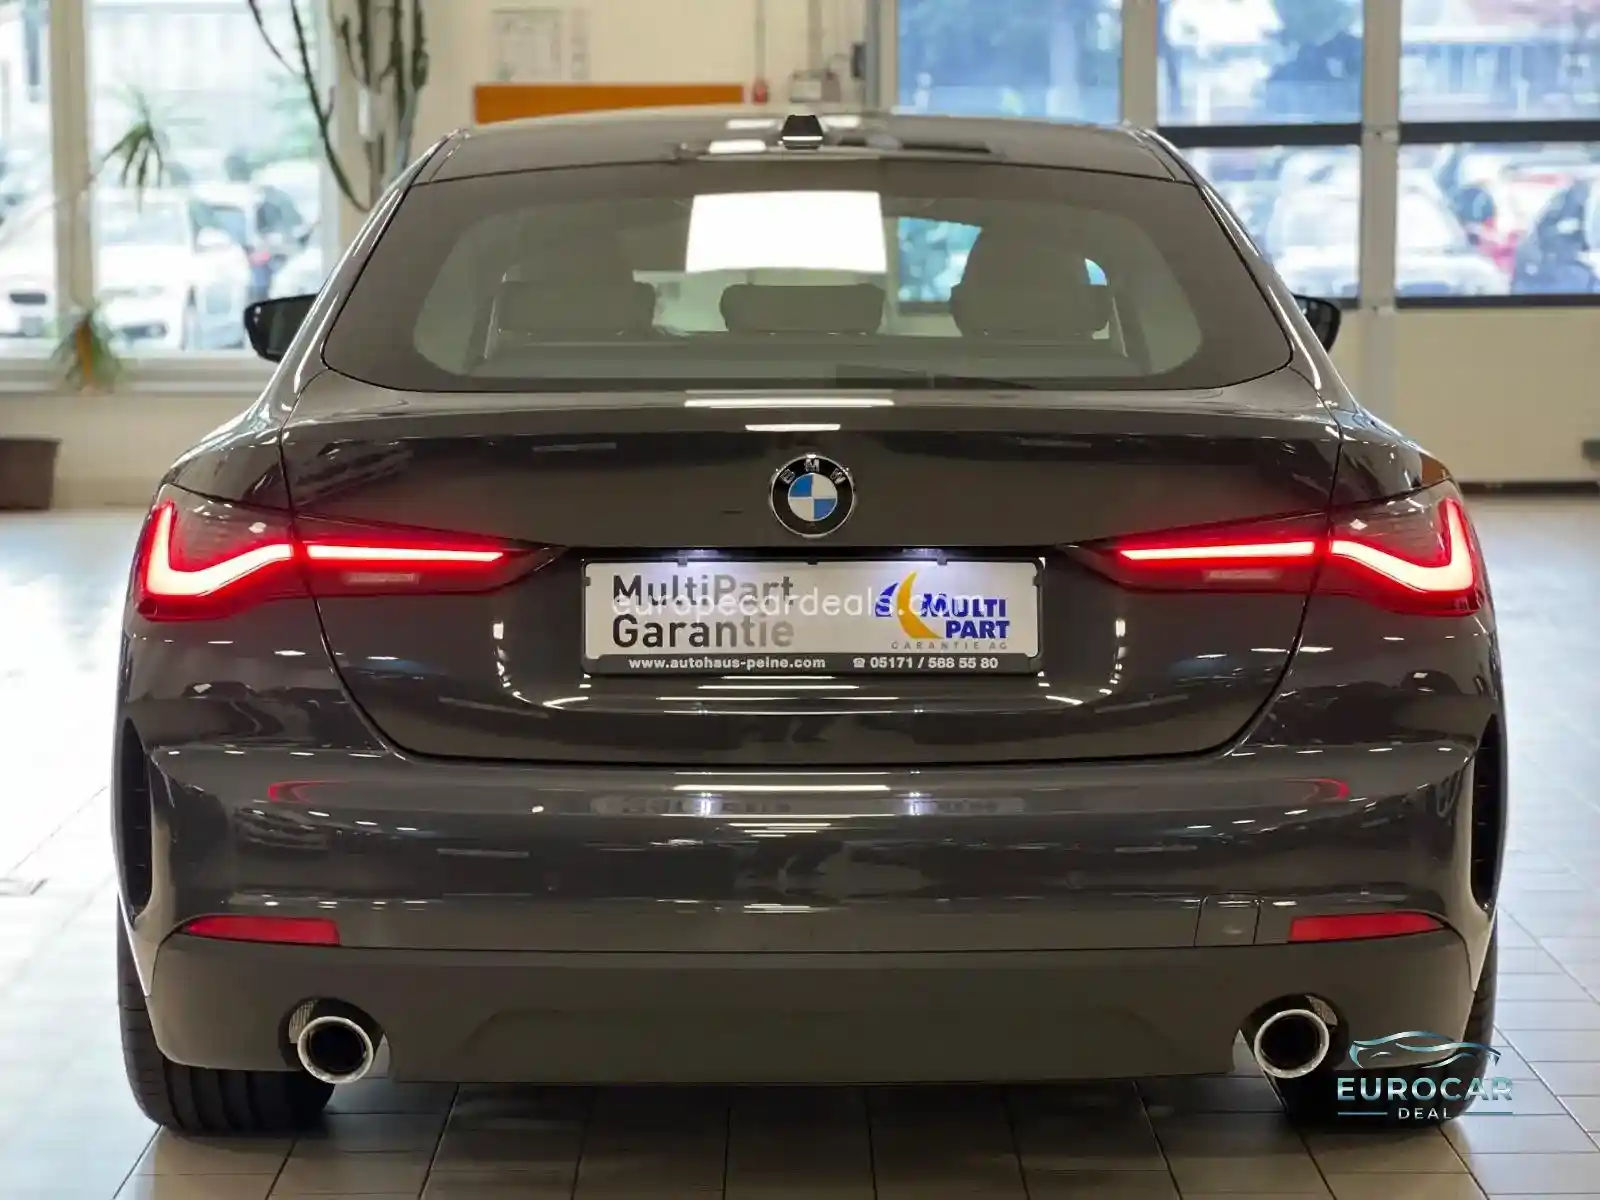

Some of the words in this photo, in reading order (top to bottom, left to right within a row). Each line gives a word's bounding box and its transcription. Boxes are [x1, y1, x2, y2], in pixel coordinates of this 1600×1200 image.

[780, 458, 846, 484] BMW
[612, 574, 794, 606] MultiPart
[920, 593, 1006, 618] MULTI
[612, 613, 795, 648] Garantie
[945, 620, 1011, 639] PART
[890, 641, 980, 650] GARANTIE
[989, 641, 1008, 650] AG
[628, 656, 826, 671] www.autohaus-peine.com
[870, 656, 914, 669] 05171
[958, 656, 977, 669] 55
[980, 656, 999, 669] 80
